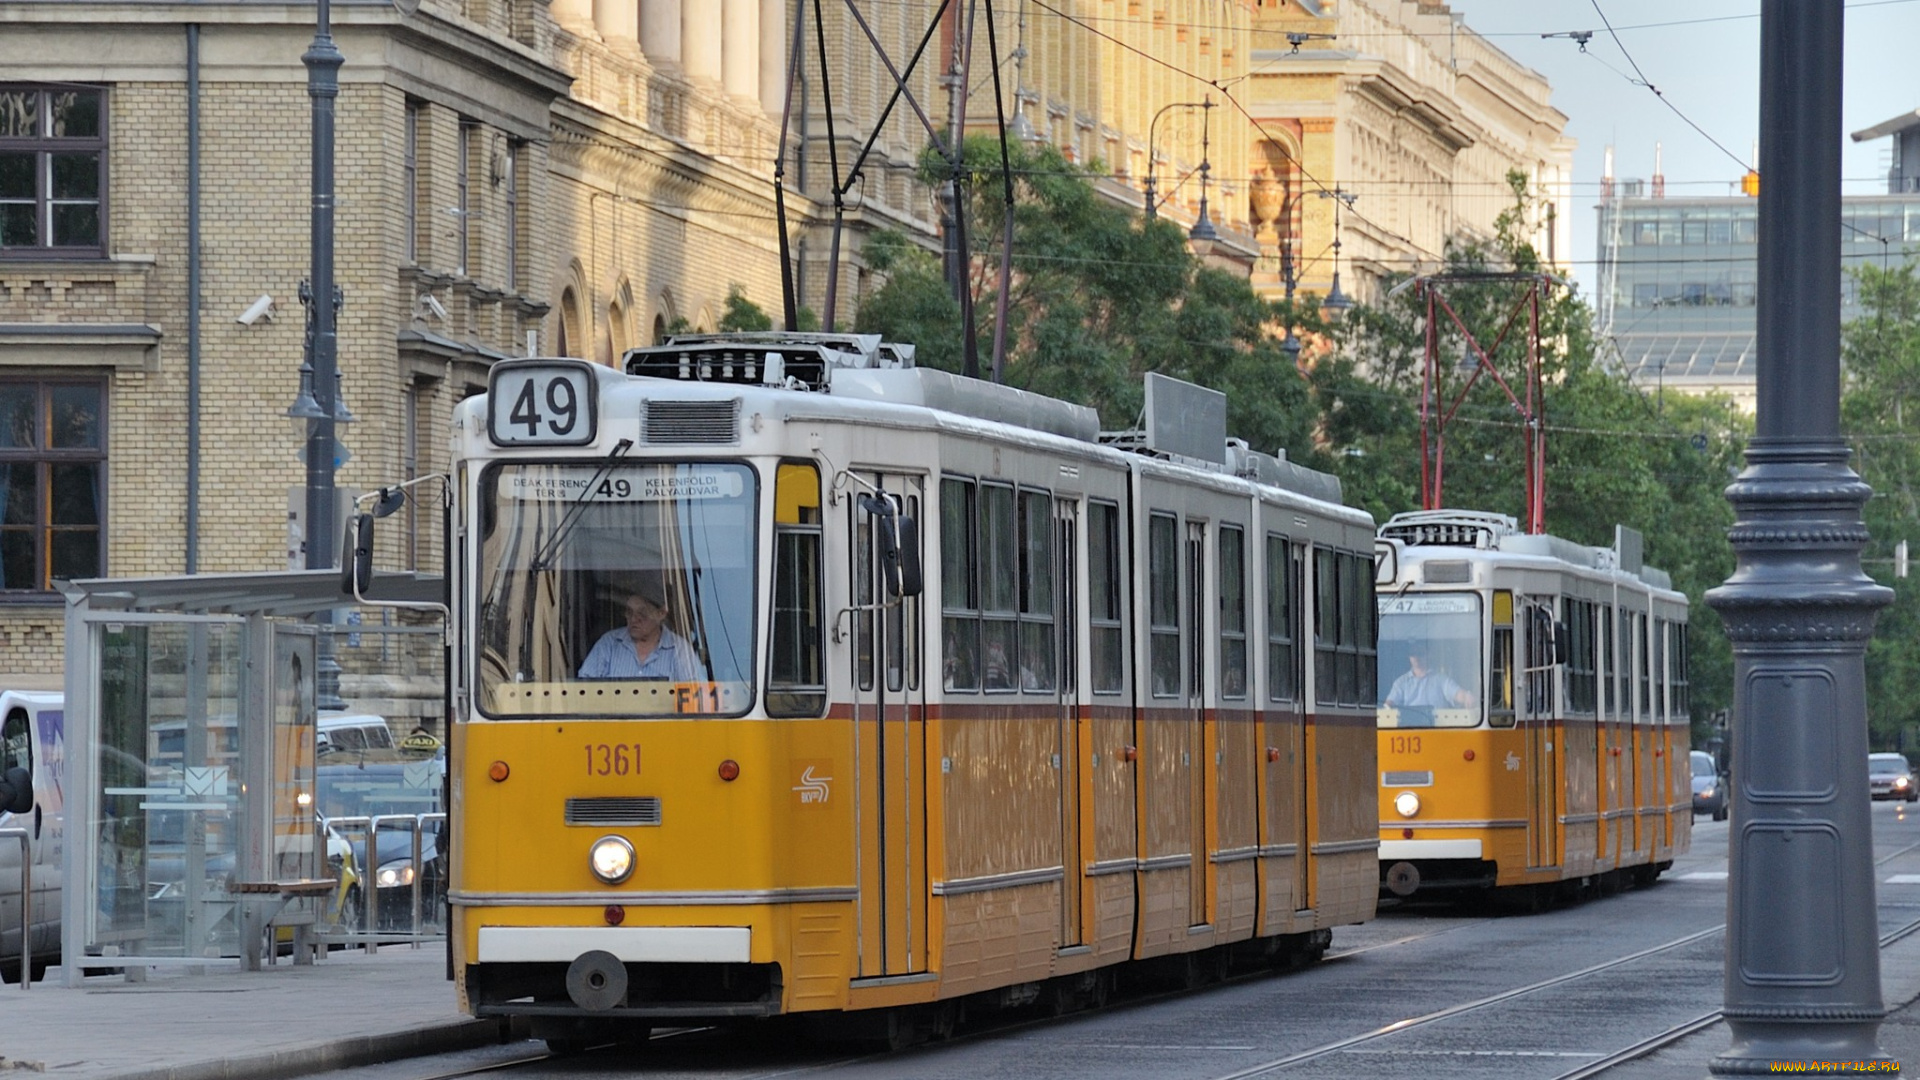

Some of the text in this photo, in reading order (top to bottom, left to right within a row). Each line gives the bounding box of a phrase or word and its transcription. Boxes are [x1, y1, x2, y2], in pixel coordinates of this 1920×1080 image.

[510, 376, 578, 437] 49
[545, 479, 588, 489] FERENC
[597, 479, 631, 498] 49
[1395, 601, 1414, 612] 47
[677, 686, 719, 713] F11
[407, 738, 433, 746] TAXI
[1390, 736, 1421, 754] 1313
[584, 743, 641, 776] 1361
